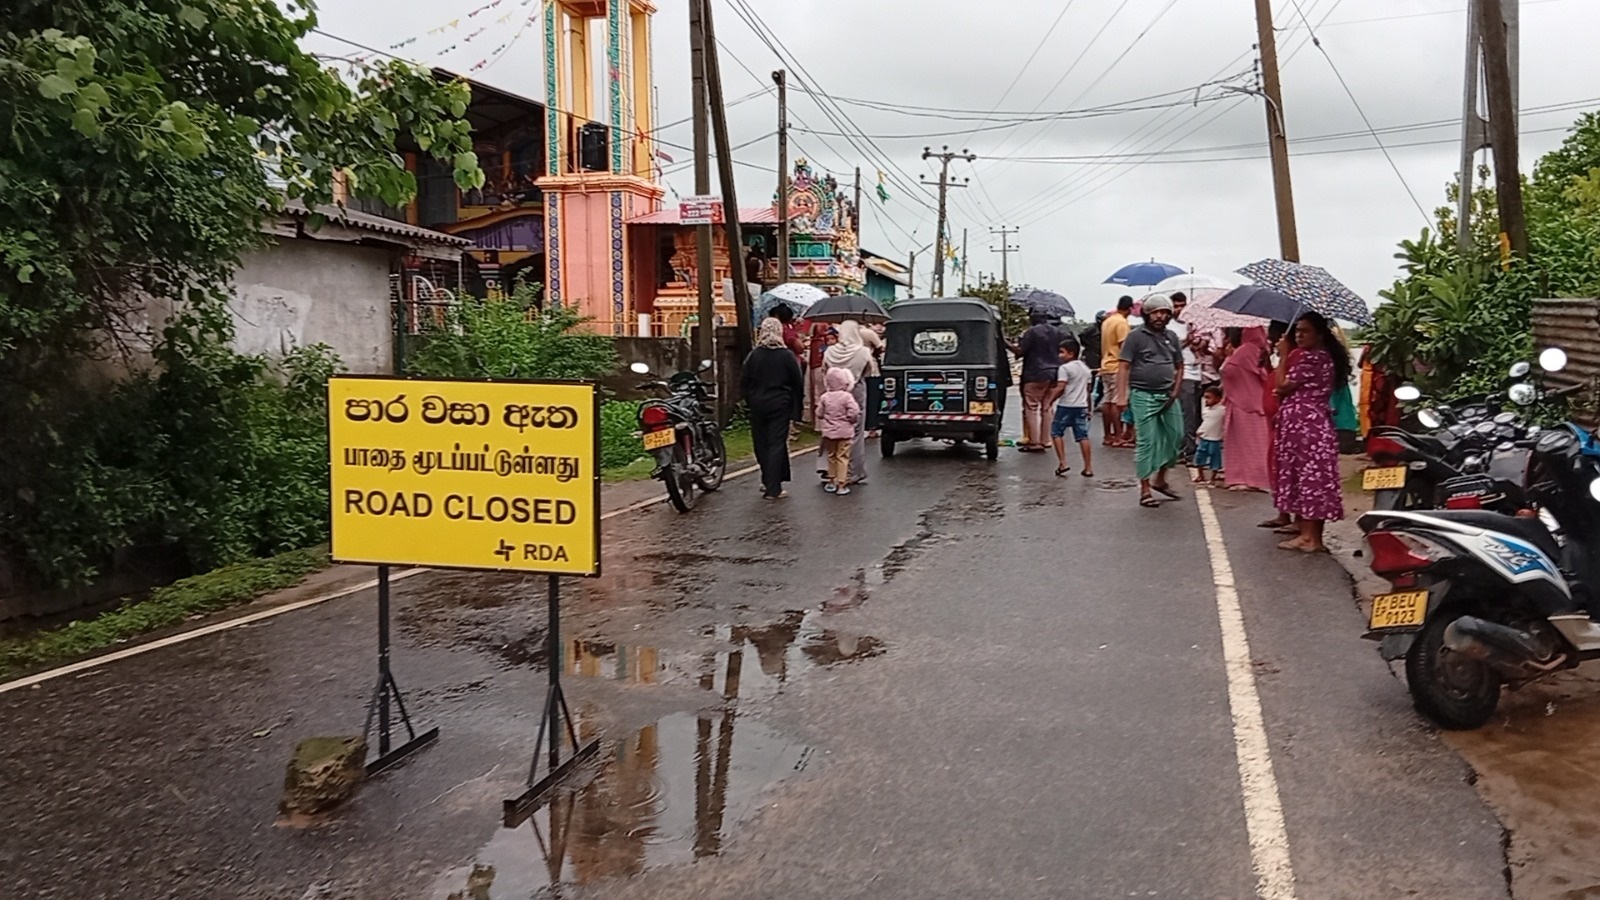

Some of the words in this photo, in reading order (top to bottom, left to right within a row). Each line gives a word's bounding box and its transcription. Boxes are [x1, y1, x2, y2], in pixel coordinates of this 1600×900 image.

[345, 394, 409, 423] පාර
[421, 395, 490, 426] වසා
[503, 404, 579, 433] ඇත
[344, 447, 406, 473] பாதை
[412, 442, 580, 482] மூடப்பட்டுள்ளது
[345, 489, 433, 518] ROAD
[444, 494, 577, 525] CLOSED
[523, 544, 569, 562] RDA
[1390, 594, 1417, 610] BEU
[1385, 609, 1416, 625] 9123
